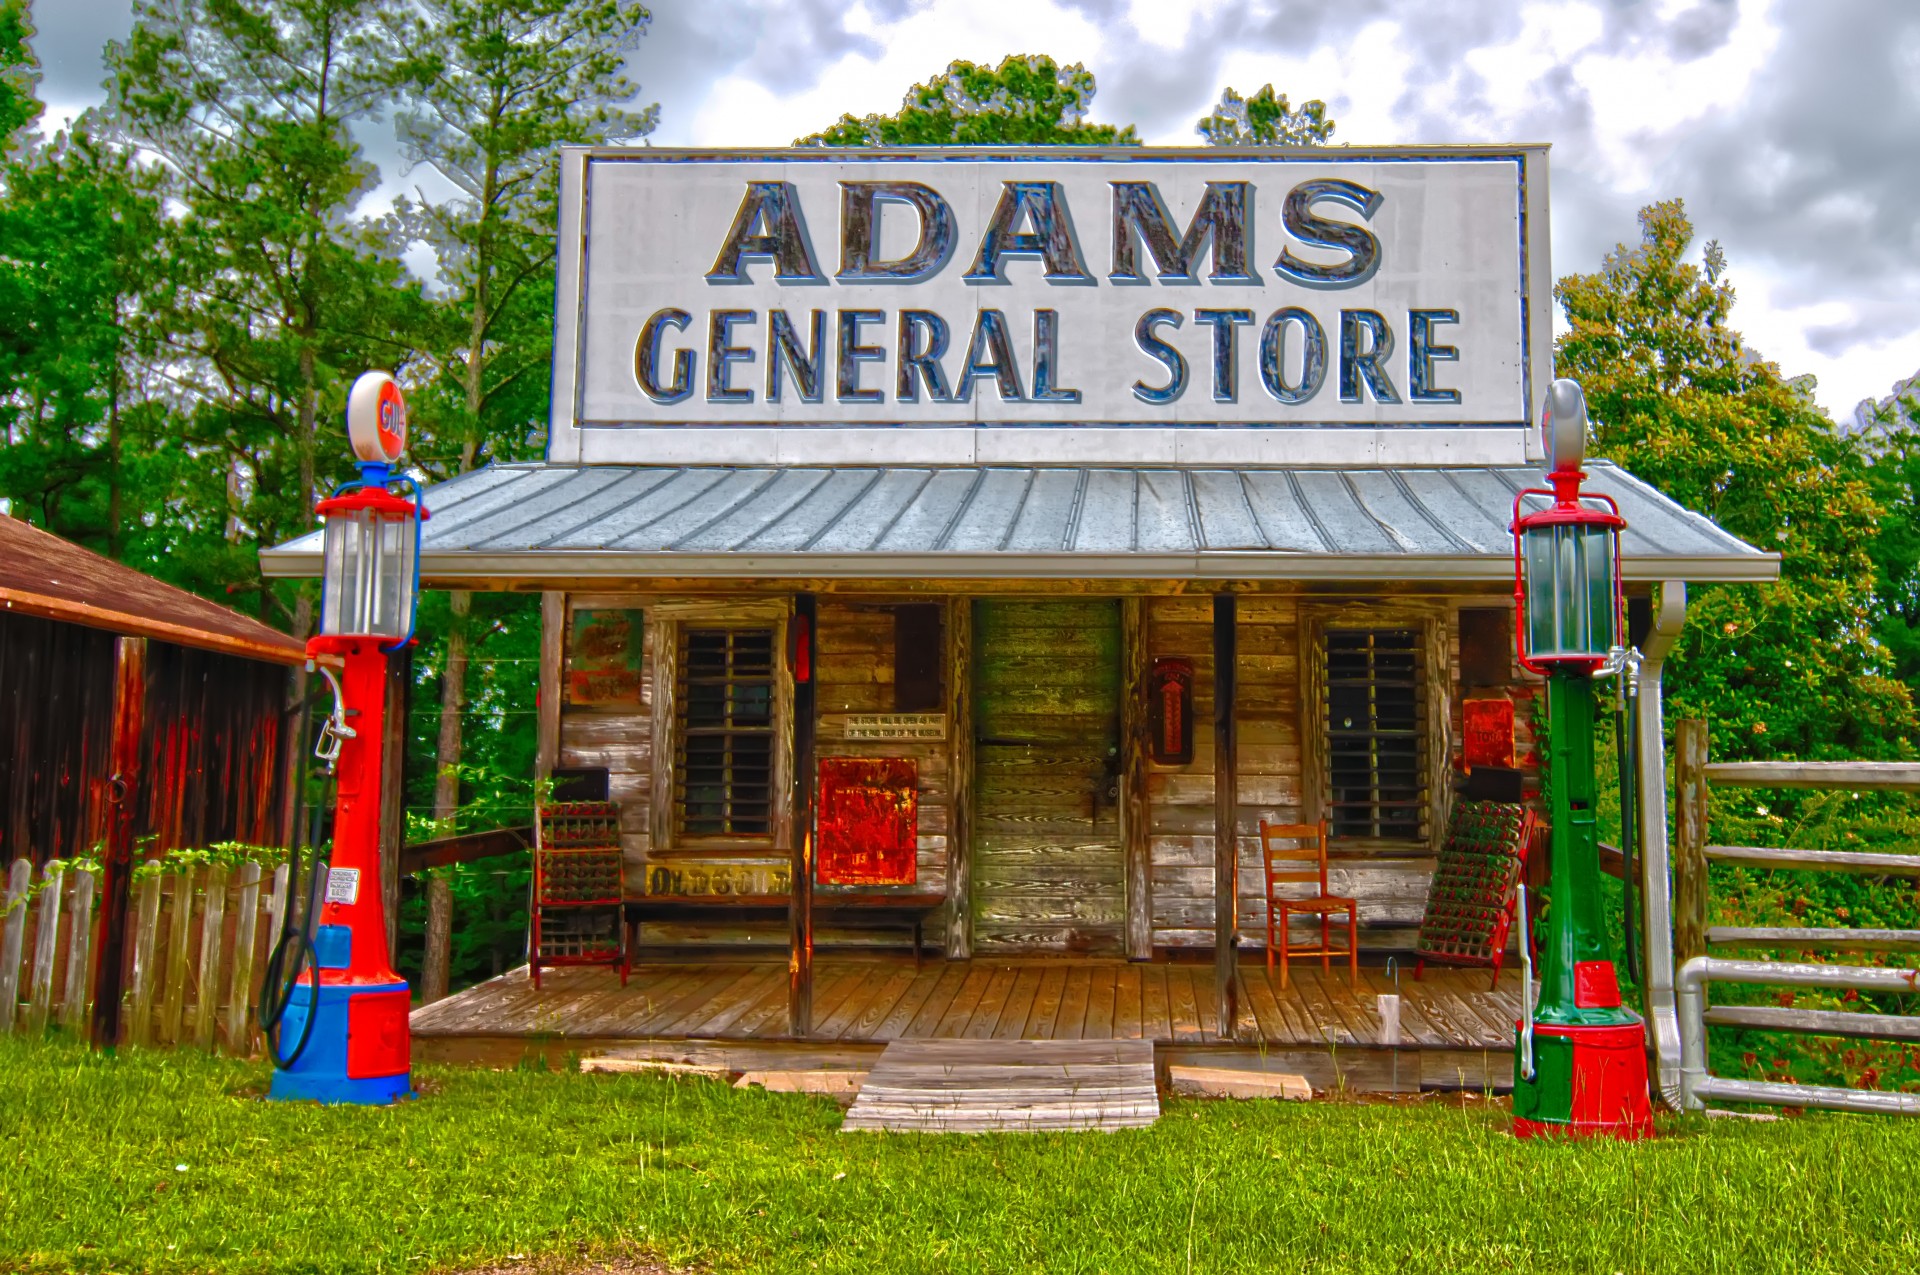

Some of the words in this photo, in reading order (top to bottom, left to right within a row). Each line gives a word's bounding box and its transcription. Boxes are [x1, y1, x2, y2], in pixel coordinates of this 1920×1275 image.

[704, 178, 1383, 290] ADAMS
[634, 307, 1083, 404] GENERAL
[1131, 306, 1463, 405] STORE
[848, 716, 859, 724] THE
[861, 716, 878, 724] STORE
[880, 716, 892, 724] WILL
[894, 716, 901, 724] BE
[903, 716, 917, 724] OPEN
[919, 716, 927, 724] AS
[848, 729, 855, 737] OF
[857, 729, 867, 737] THE
[869, 729, 880, 737] PAID
[882, 729, 895, 737] TOUR
[897, 729, 905, 737] OF
[906, 729, 916, 737] THE
